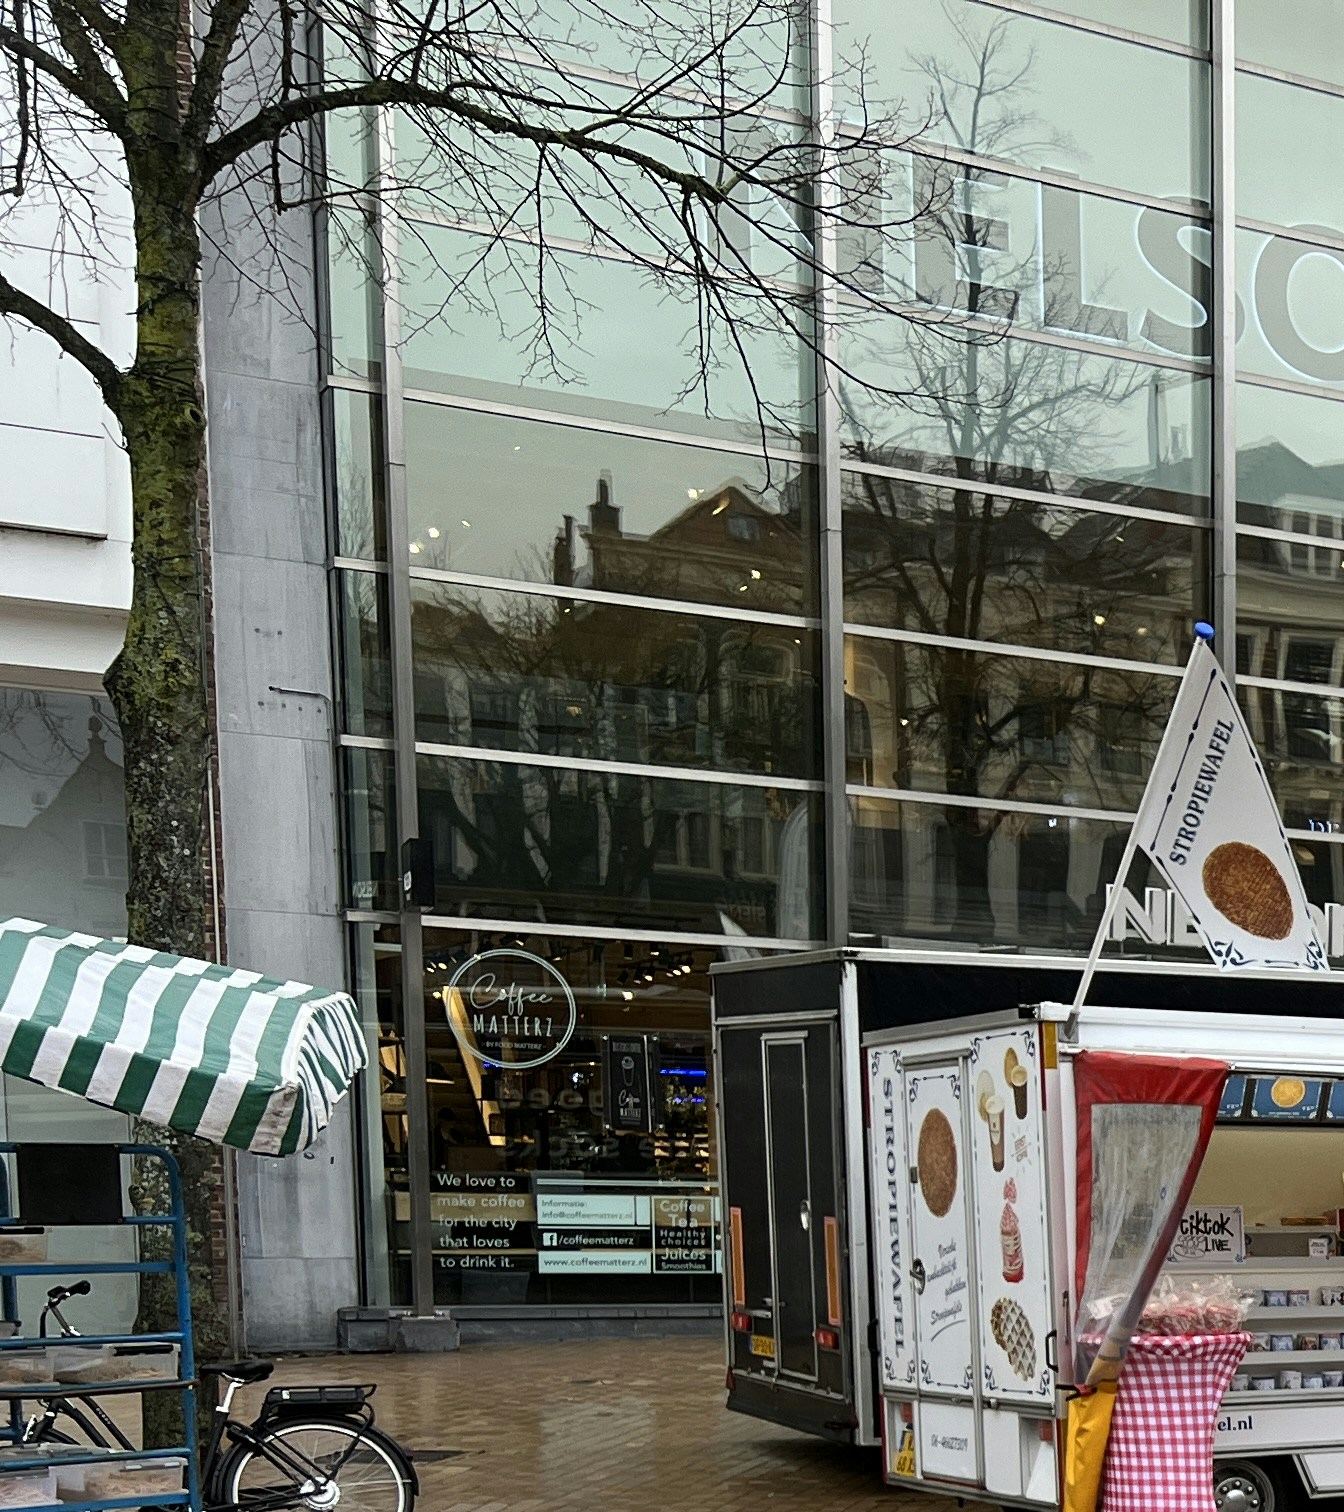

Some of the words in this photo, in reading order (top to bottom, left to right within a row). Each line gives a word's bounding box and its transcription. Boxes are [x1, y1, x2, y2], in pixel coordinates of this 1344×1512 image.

[1169, 719, 1234, 867] STROPIEWAFEL
[470, 973, 553, 1016] Coffee
[473, 1013, 552, 1037] MATTERZ
[437, 1173, 461, 1186] We
[465, 1173, 496, 1187] love
[500, 1176, 516, 1187] to
[437, 1193, 476, 1207] make
[481, 1194, 525, 1208] coffee
[660, 1200, 705, 1213] Coffee
[439, 1214, 458, 1227] for
[464, 1214, 488, 1228] the
[492, 1214, 517, 1231] city
[667, 1214, 698, 1228] Tea
[883, 1077, 905, 1359] STROPIEWAFEL
[660, 1228, 706, 1239] Healthy
[440, 1234, 469, 1247] that
[473, 1234, 510, 1248] loves
[661, 1237, 706, 1246] choices
[1204, 1236, 1232, 1252] LIVE
[661, 1247, 707, 1260] Juices
[440, 1256, 456, 1268] to
[460, 1255, 497, 1268] drink
[500, 1256, 515, 1268] it.
[543, 1258, 648, 1267] www.coffeematterz.nl
